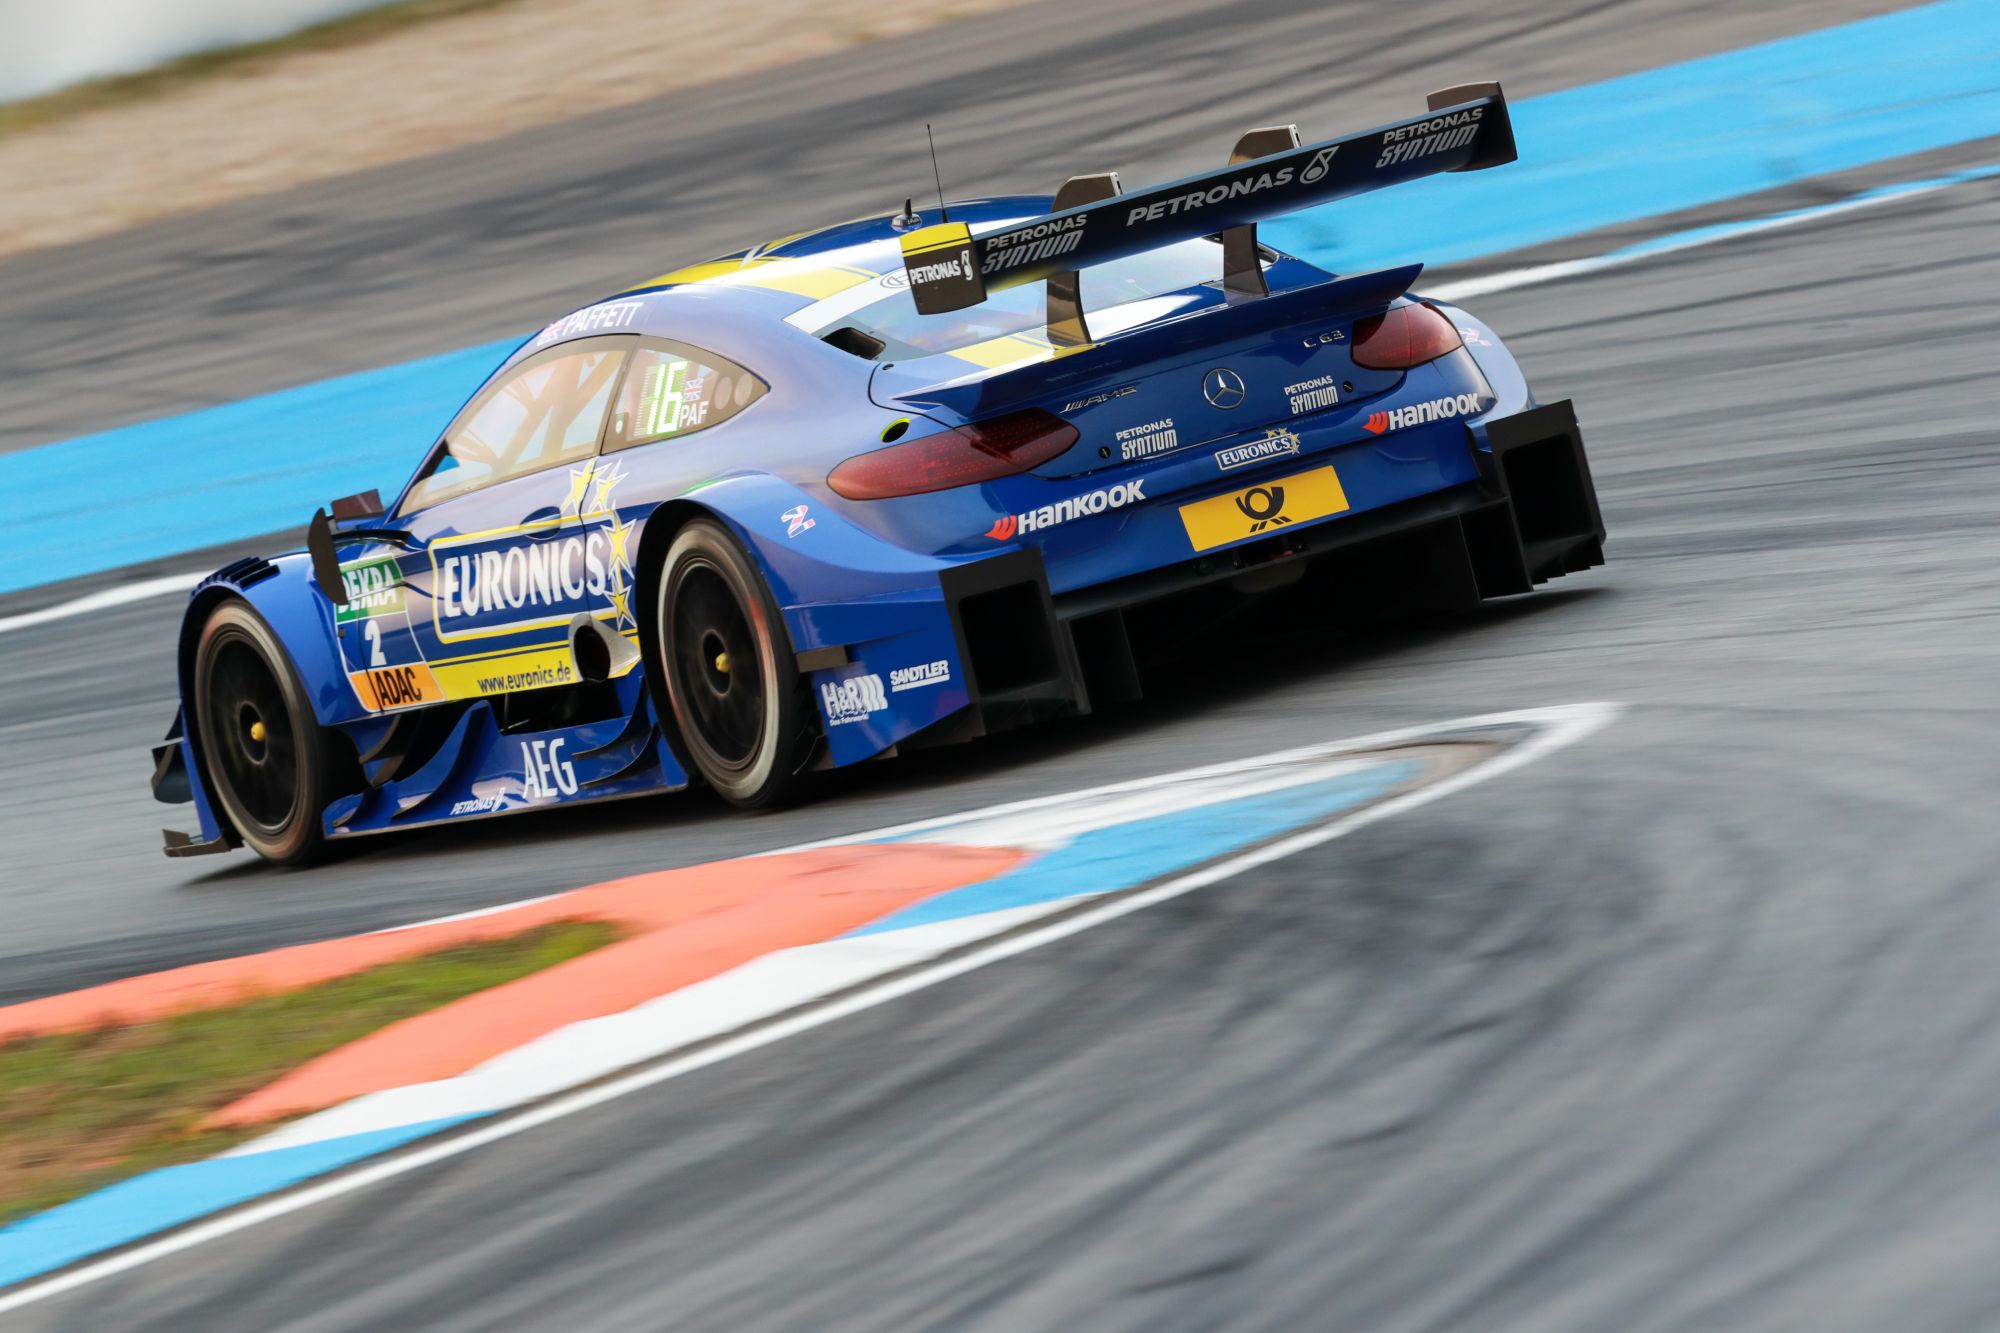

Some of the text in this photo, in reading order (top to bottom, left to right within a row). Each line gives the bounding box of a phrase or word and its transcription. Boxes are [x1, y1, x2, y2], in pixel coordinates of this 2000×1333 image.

[1382, 107, 1483, 145] PETRONAS
[1375, 123, 1479, 169] SYNTIUM
[1126, 166, 1293, 227] PETRONAS
[986, 214, 1088, 251] PETRONAS
[981, 229, 1084, 275] SYNTIUM
[909, 259, 961, 285] PETRONAS
[562, 302, 644, 336] PAFFETT
[1303, 330, 1345, 348] C 63
[646, 361, 689, 435] 16
[1284, 375, 1334, 396] PETRONAS
[1290, 386, 1339, 415] SYNTIUM
[679, 401, 709, 427] PAF
[1115, 418, 1174, 441] PETRONAS
[1121, 429, 1178, 460] SYNTIUM
[1221, 436, 1292, 466] EURONICS
[444, 533, 606, 617] EURONICS
[364, 619, 387, 667] 2
[374, 667, 422, 706] ADAC
[477, 661, 571, 692] www.euronics.de
[890, 660, 949, 686] SANDTLER
[520, 738, 579, 799] AEG
[450, 795, 494, 815] PETRONAS
